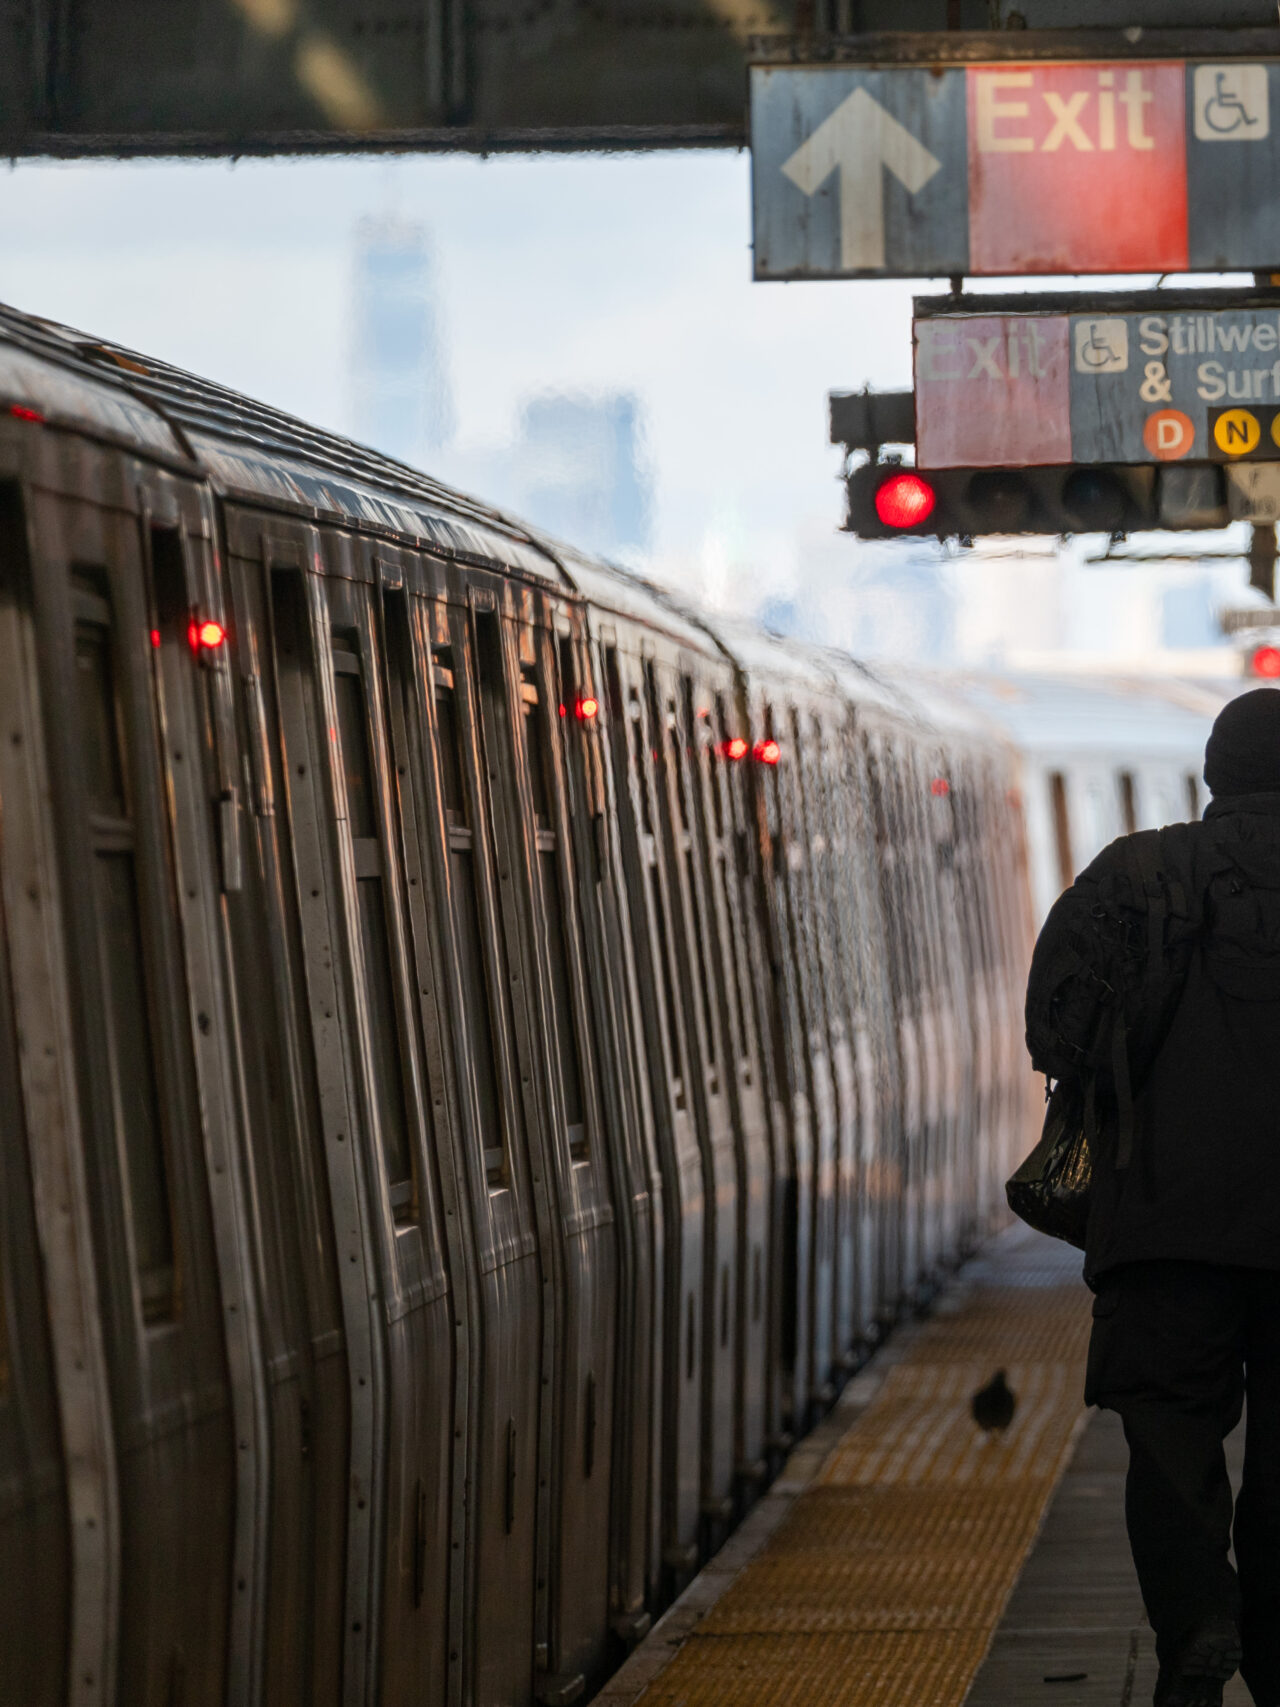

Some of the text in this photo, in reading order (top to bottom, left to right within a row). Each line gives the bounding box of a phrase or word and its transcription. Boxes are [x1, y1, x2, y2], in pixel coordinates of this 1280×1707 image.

[976, 71, 1154, 152] Exit
[917, 321, 1048, 382] Exit
[1139, 364, 1172, 402] &
[1158, 419, 1184, 450] D
[1226, 419, 1249, 444] N
